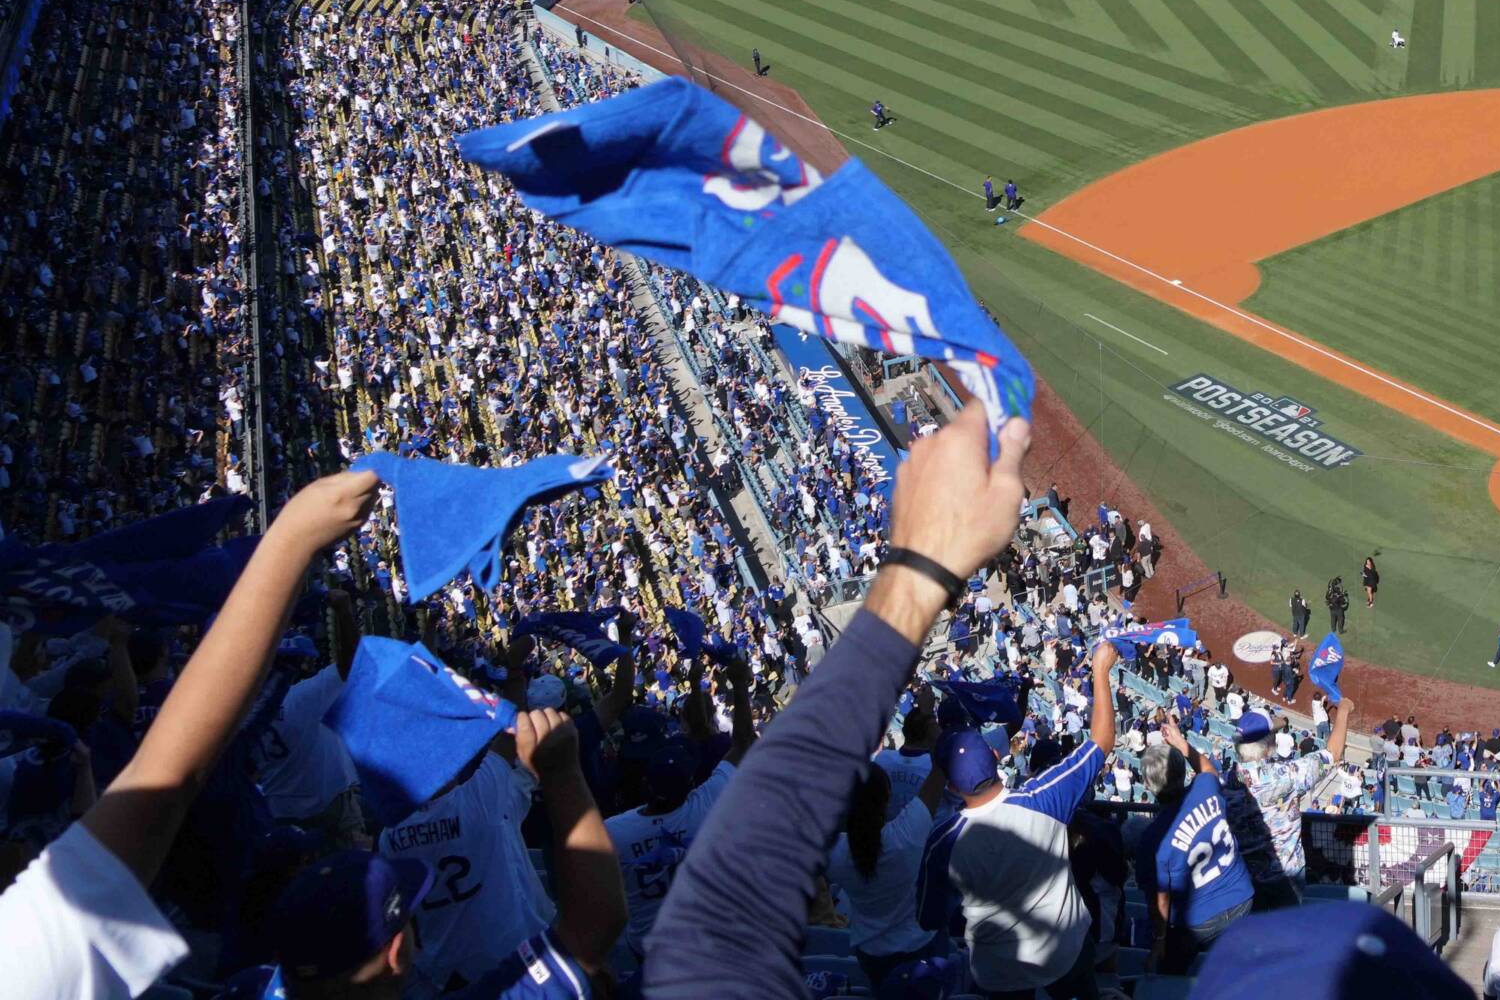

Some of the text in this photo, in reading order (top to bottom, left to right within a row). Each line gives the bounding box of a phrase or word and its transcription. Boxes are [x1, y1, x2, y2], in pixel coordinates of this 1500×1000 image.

[1176, 376, 1354, 467] POSTSEASON
[387, 816, 461, 853] KERSHAW
[1171, 796, 1221, 852] GONZALEZ
[1187, 818, 1235, 889] 23
